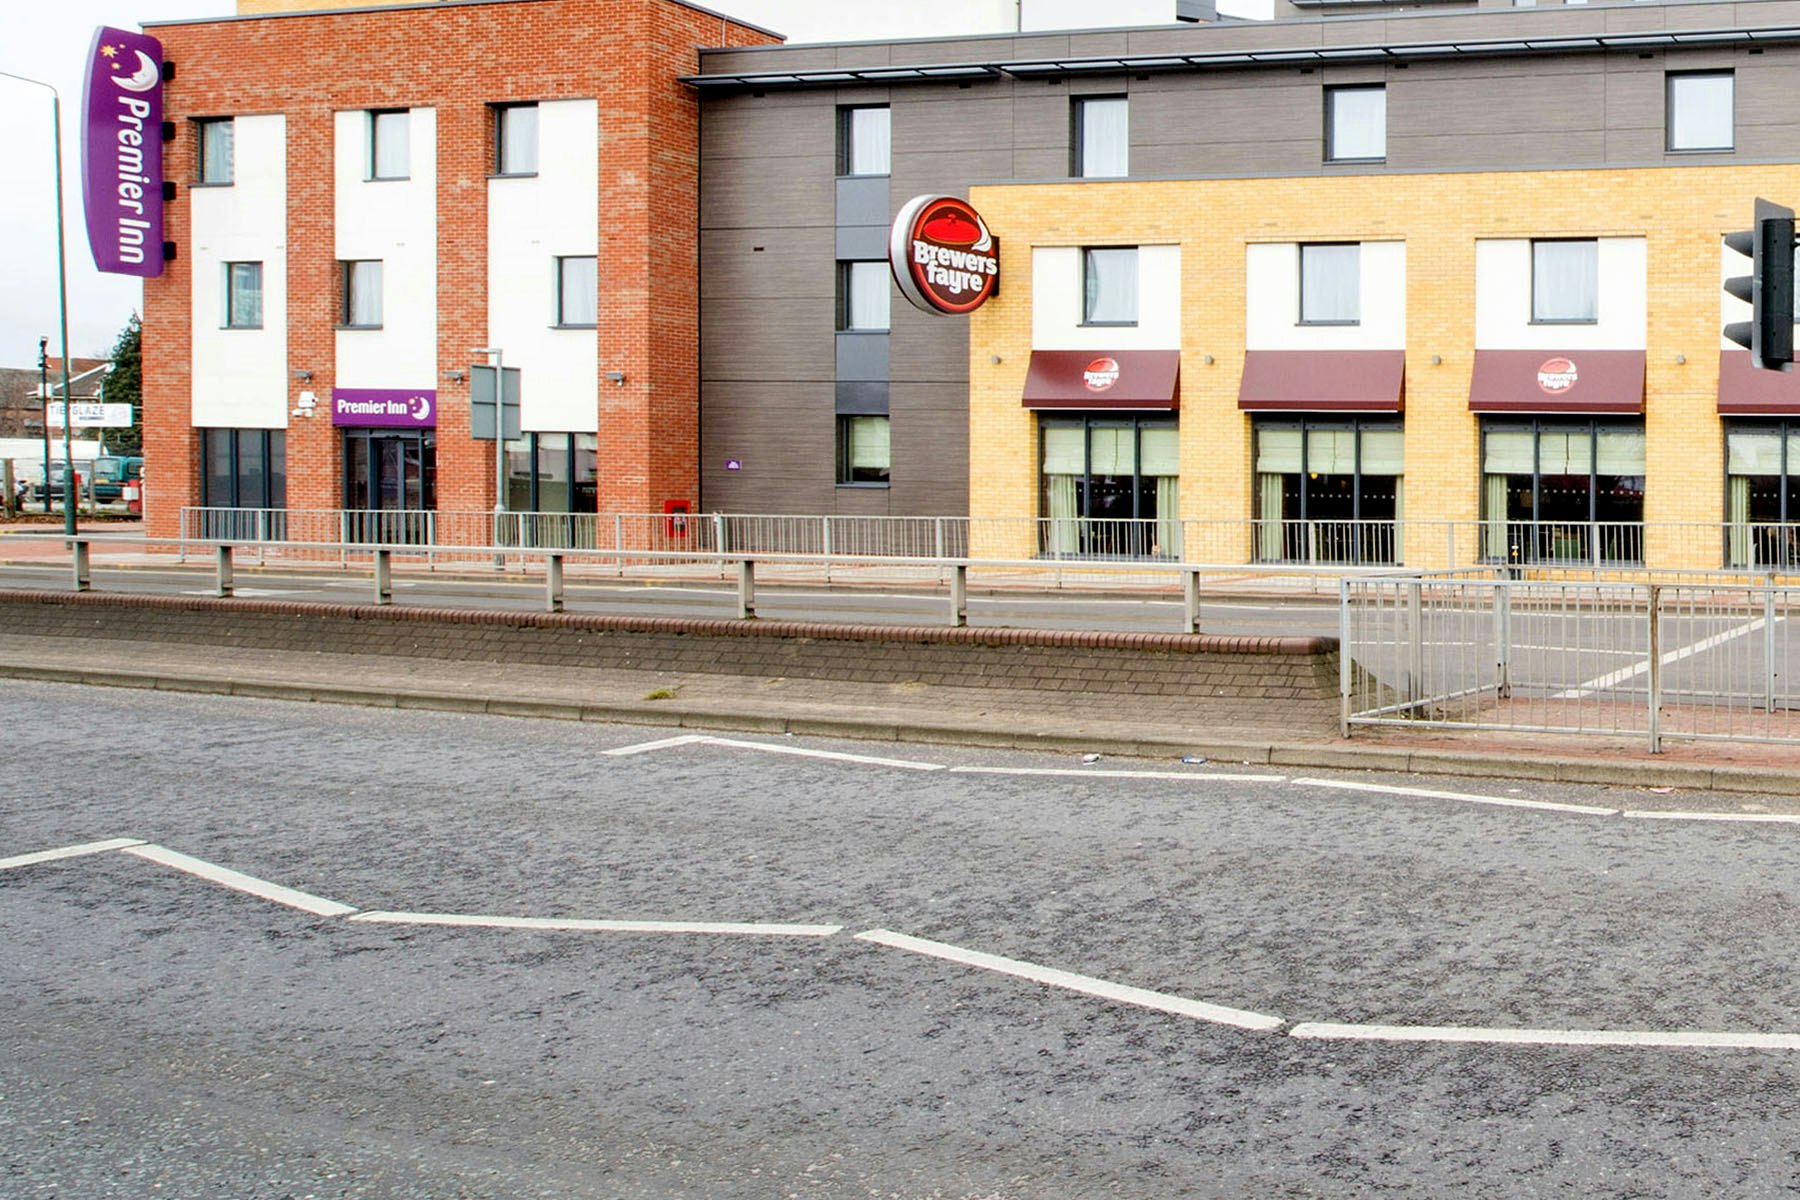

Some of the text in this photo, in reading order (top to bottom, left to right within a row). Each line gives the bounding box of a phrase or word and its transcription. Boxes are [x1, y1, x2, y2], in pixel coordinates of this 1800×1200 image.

[118, 96, 150, 264] Premier Inn
[913, 240, 997, 275] Brewers
[926, 260, 983, 294] fayre
[337, 399, 408, 414] Premier Inn
